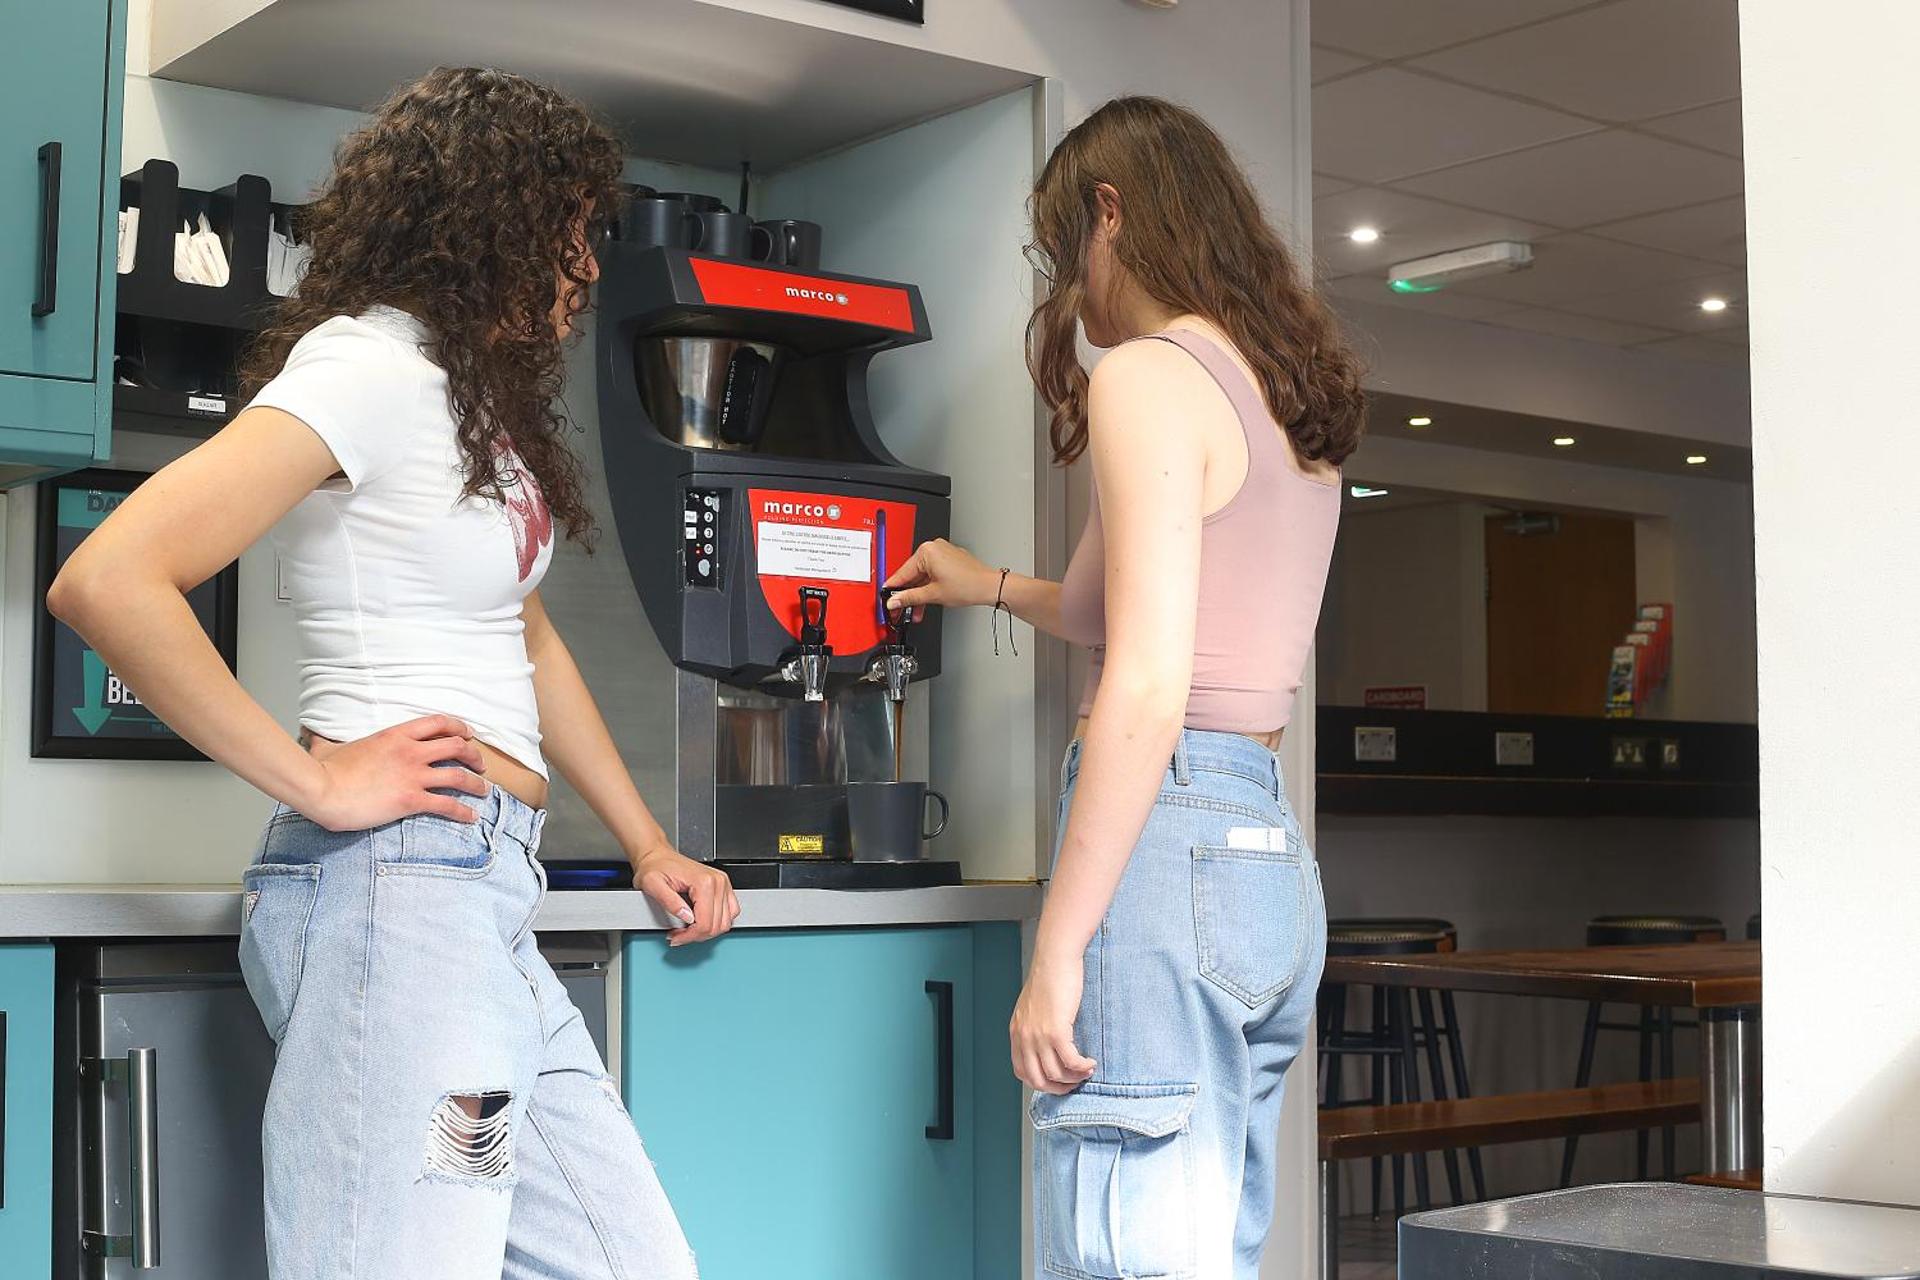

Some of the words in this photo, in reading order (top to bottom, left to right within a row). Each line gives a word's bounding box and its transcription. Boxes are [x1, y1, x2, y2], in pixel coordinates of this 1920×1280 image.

[785, 287, 834, 302] marco
[725, 360, 737, 403] CAUTION
[764, 501, 824, 517] marco
[107, 676, 143, 705] BE
